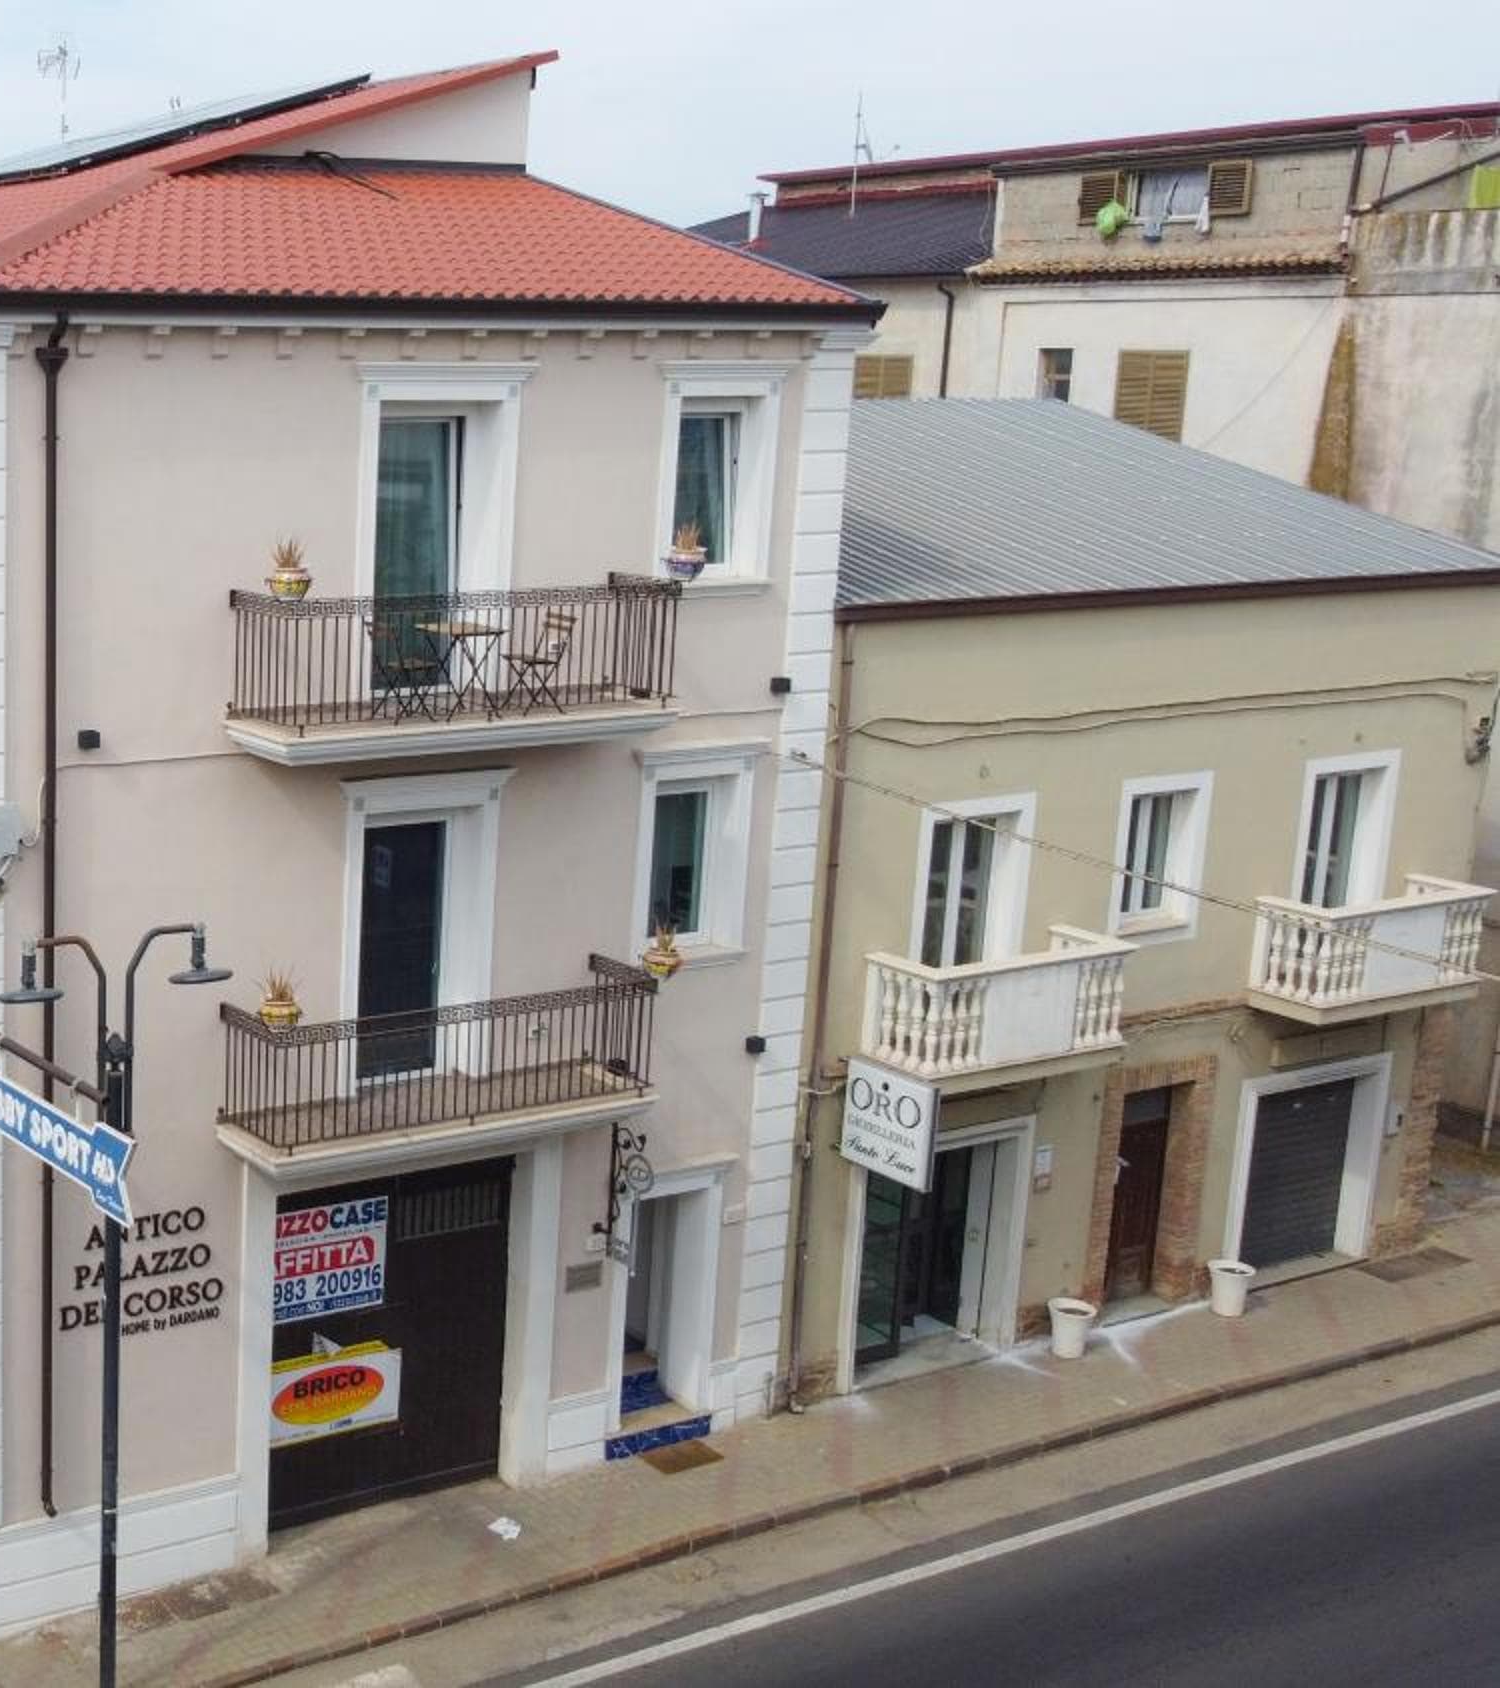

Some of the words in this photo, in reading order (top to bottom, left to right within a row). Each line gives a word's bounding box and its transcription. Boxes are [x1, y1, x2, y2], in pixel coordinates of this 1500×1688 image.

[852, 1077, 921, 1129] ORO
[30, 1109, 91, 1174] SPORT
[74, 1243, 211, 1290] PAAZZO
[275, 1239, 370, 1277] FFITTA
[316, 1263, 382, 1298] 200916
[59, 1301, 104, 1331] DE
[124, 1278, 223, 1317] CORSO
[121, 1319, 150, 1337] HOME
[153, 1316, 167, 1331] by
[169, 1306, 220, 1327] DARDANO
[294, 1369, 366, 1398] BRICO
